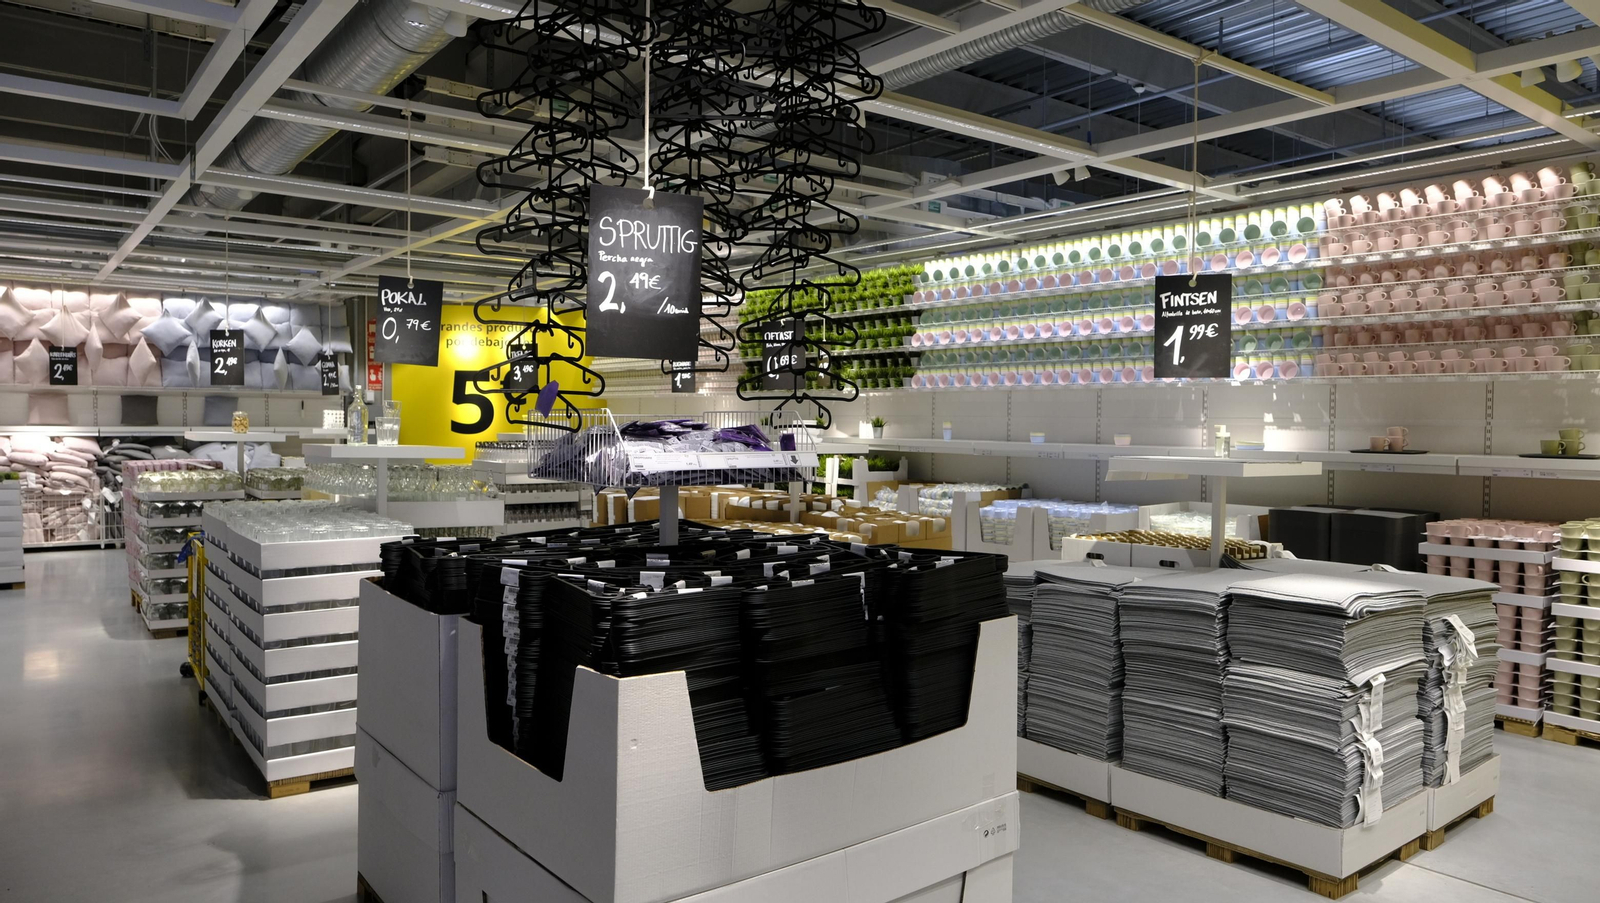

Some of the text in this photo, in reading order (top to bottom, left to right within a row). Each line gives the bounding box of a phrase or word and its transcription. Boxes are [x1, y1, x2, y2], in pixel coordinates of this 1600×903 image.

[598, 250, 628, 263] Percha
[381, 288, 427, 306] POKAL
[1159, 290, 1217, 309] FINTSEN
[440, 322, 483, 332] randes
[212, 339, 237, 348] KORKEN
